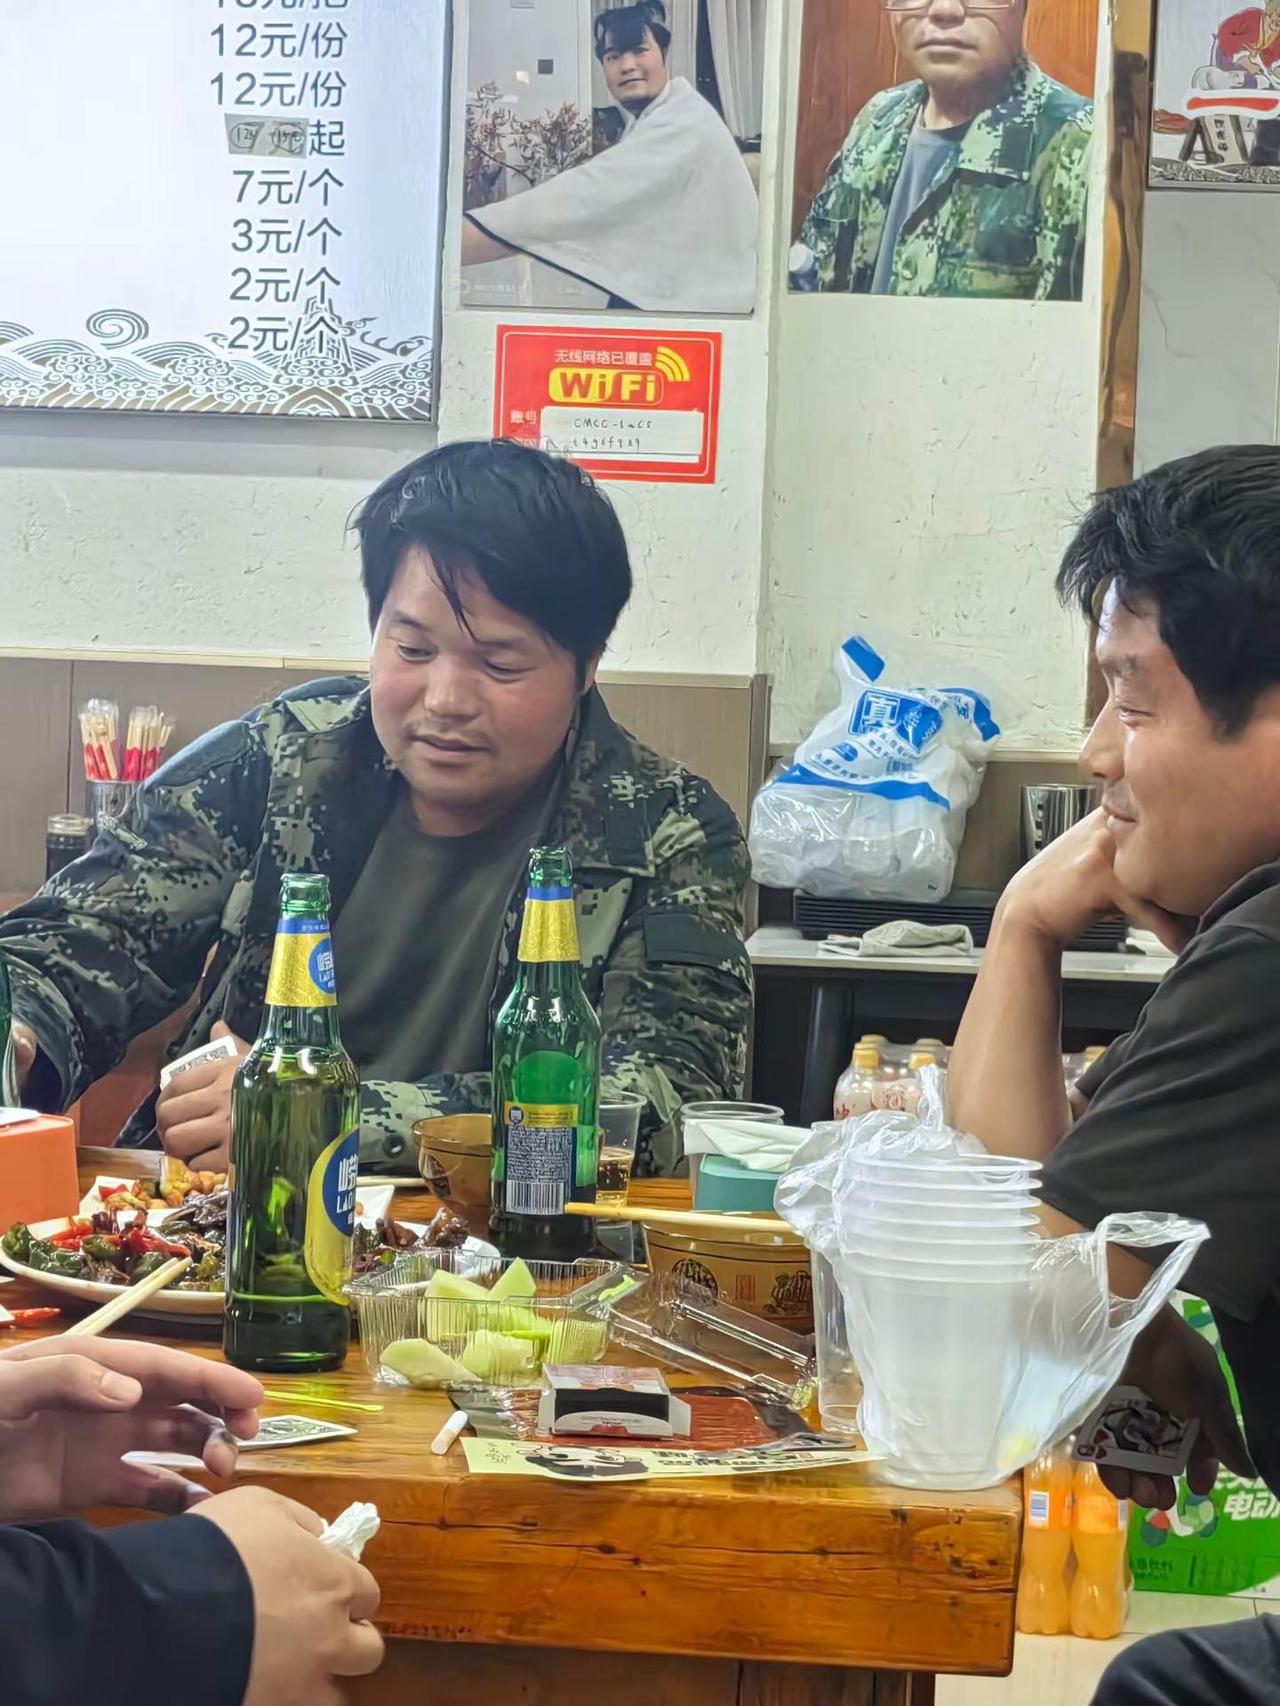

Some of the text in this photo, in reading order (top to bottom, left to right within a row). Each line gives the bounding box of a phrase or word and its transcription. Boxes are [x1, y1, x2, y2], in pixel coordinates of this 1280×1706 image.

[211, 22, 348, 58] 12元/份
[210, 71, 347, 108] 12元/份
[309, 119, 345, 156] 起
[233, 169, 344, 206] 7元/个
[231, 217, 342, 255] 3元/个
[229, 266, 341, 305] 2元/个
[228, 315, 339, 354] 2元/个
[556, 350, 653, 366] 无线网络已覆盖
[560, 372, 656, 402] WiFi
